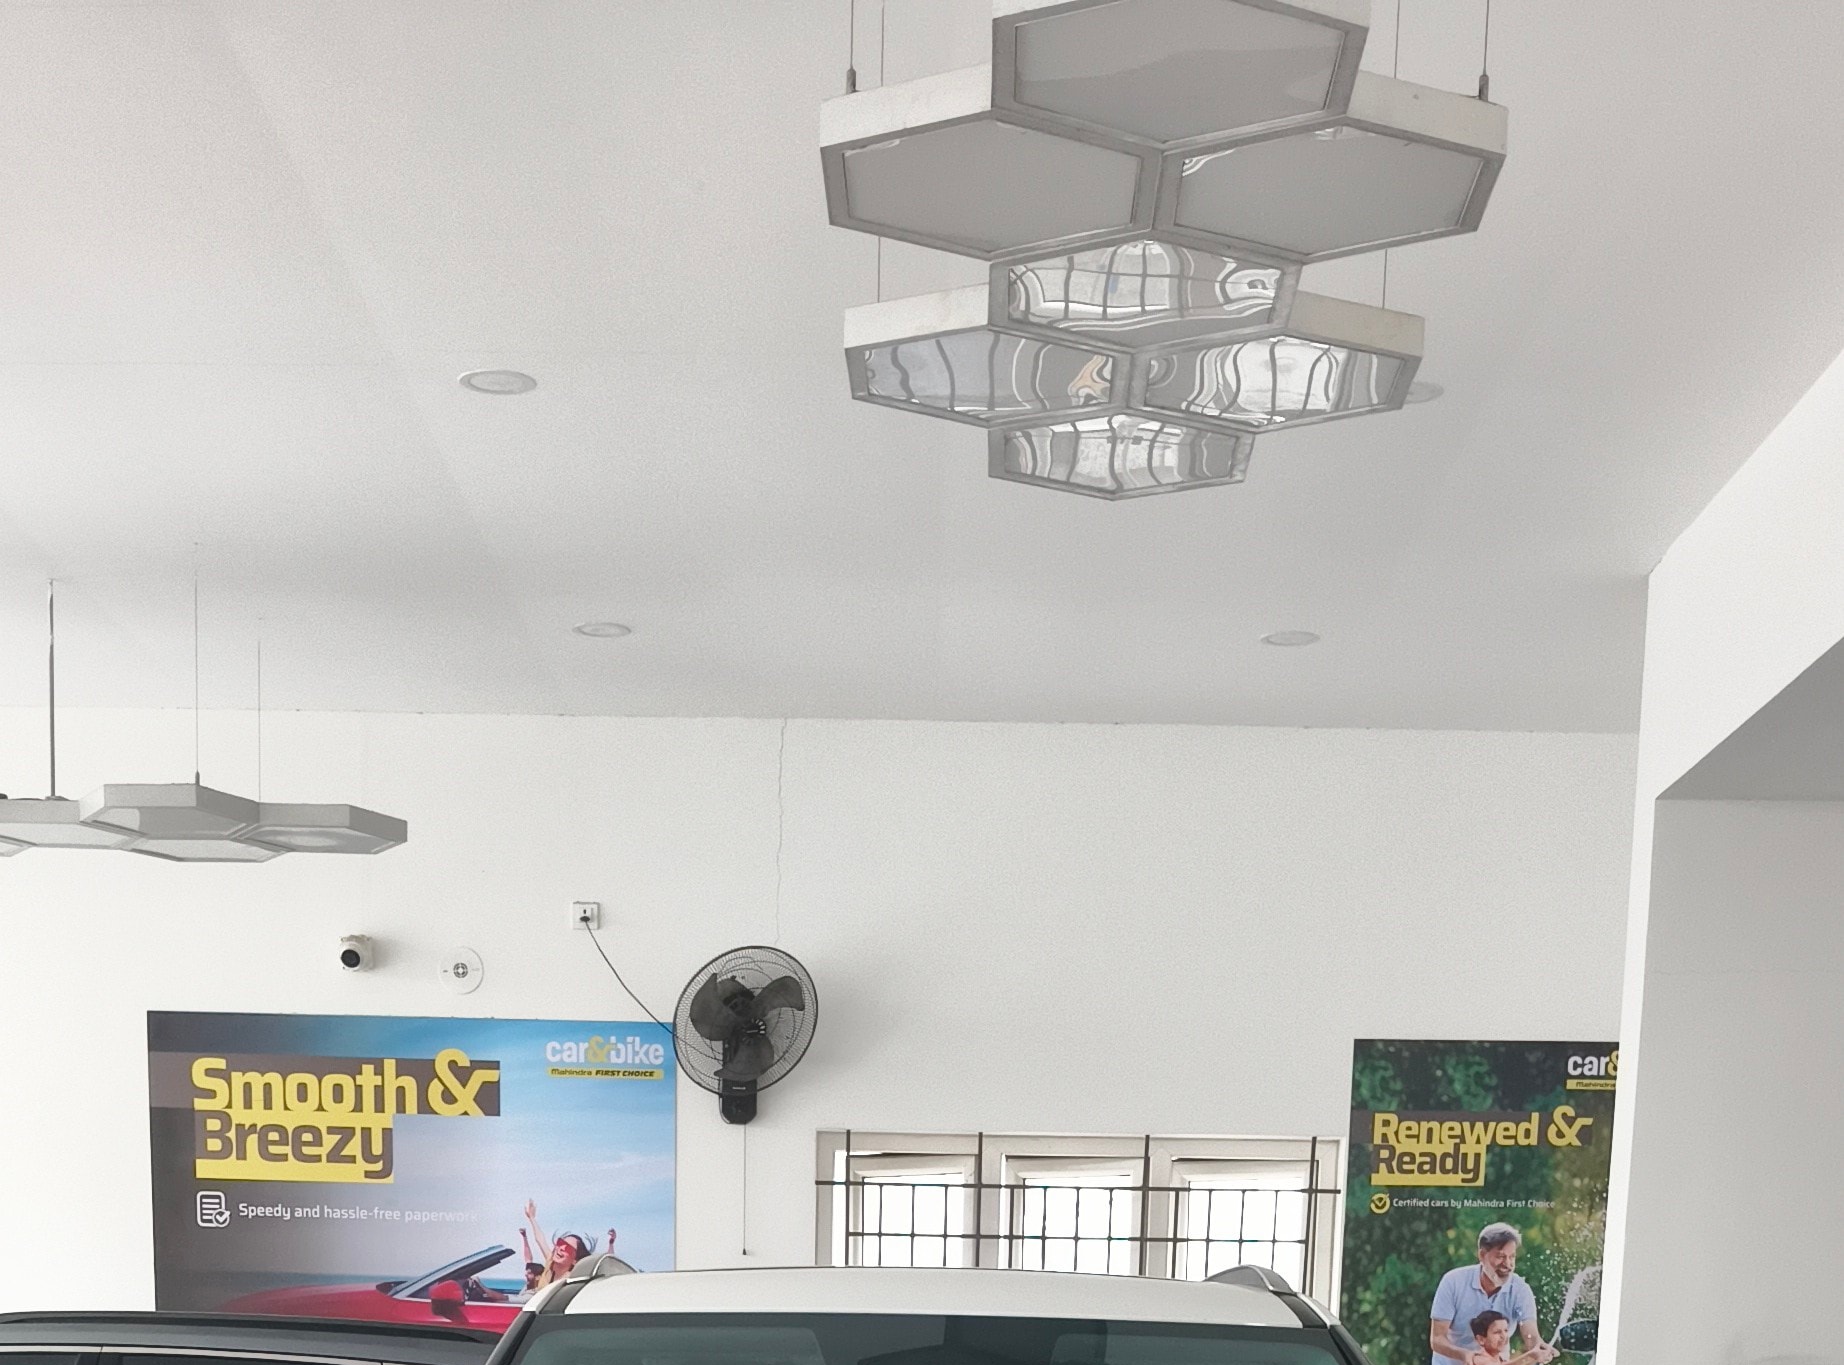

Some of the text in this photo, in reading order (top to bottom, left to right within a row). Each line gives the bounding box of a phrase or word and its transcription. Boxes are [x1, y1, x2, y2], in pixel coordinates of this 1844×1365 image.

[545, 1035, 665, 1065] car&bike
[190, 1048, 501, 1117] Smooth &
[550, 1068, 656, 1078] Mahindra FIRST CHOICE
[1372, 1105, 1594, 1147] Renewed &
[197, 1110, 394, 1180] Breezy
[1373, 1143, 1482, 1184] Ready
[238, 1202, 291, 1220] Speedy
[294, 1205, 320, 1218] and
[324, 1206, 401, 1221] hassle-free
[1392, 1197, 1429, 1208] Certified
[1430, 1199, 1449, 1208] cars
[1450, 1198, 1462, 1210] by
[1463, 1198, 1505, 1208] Mahindra
[1506, 1199, 1526, 1208] First
